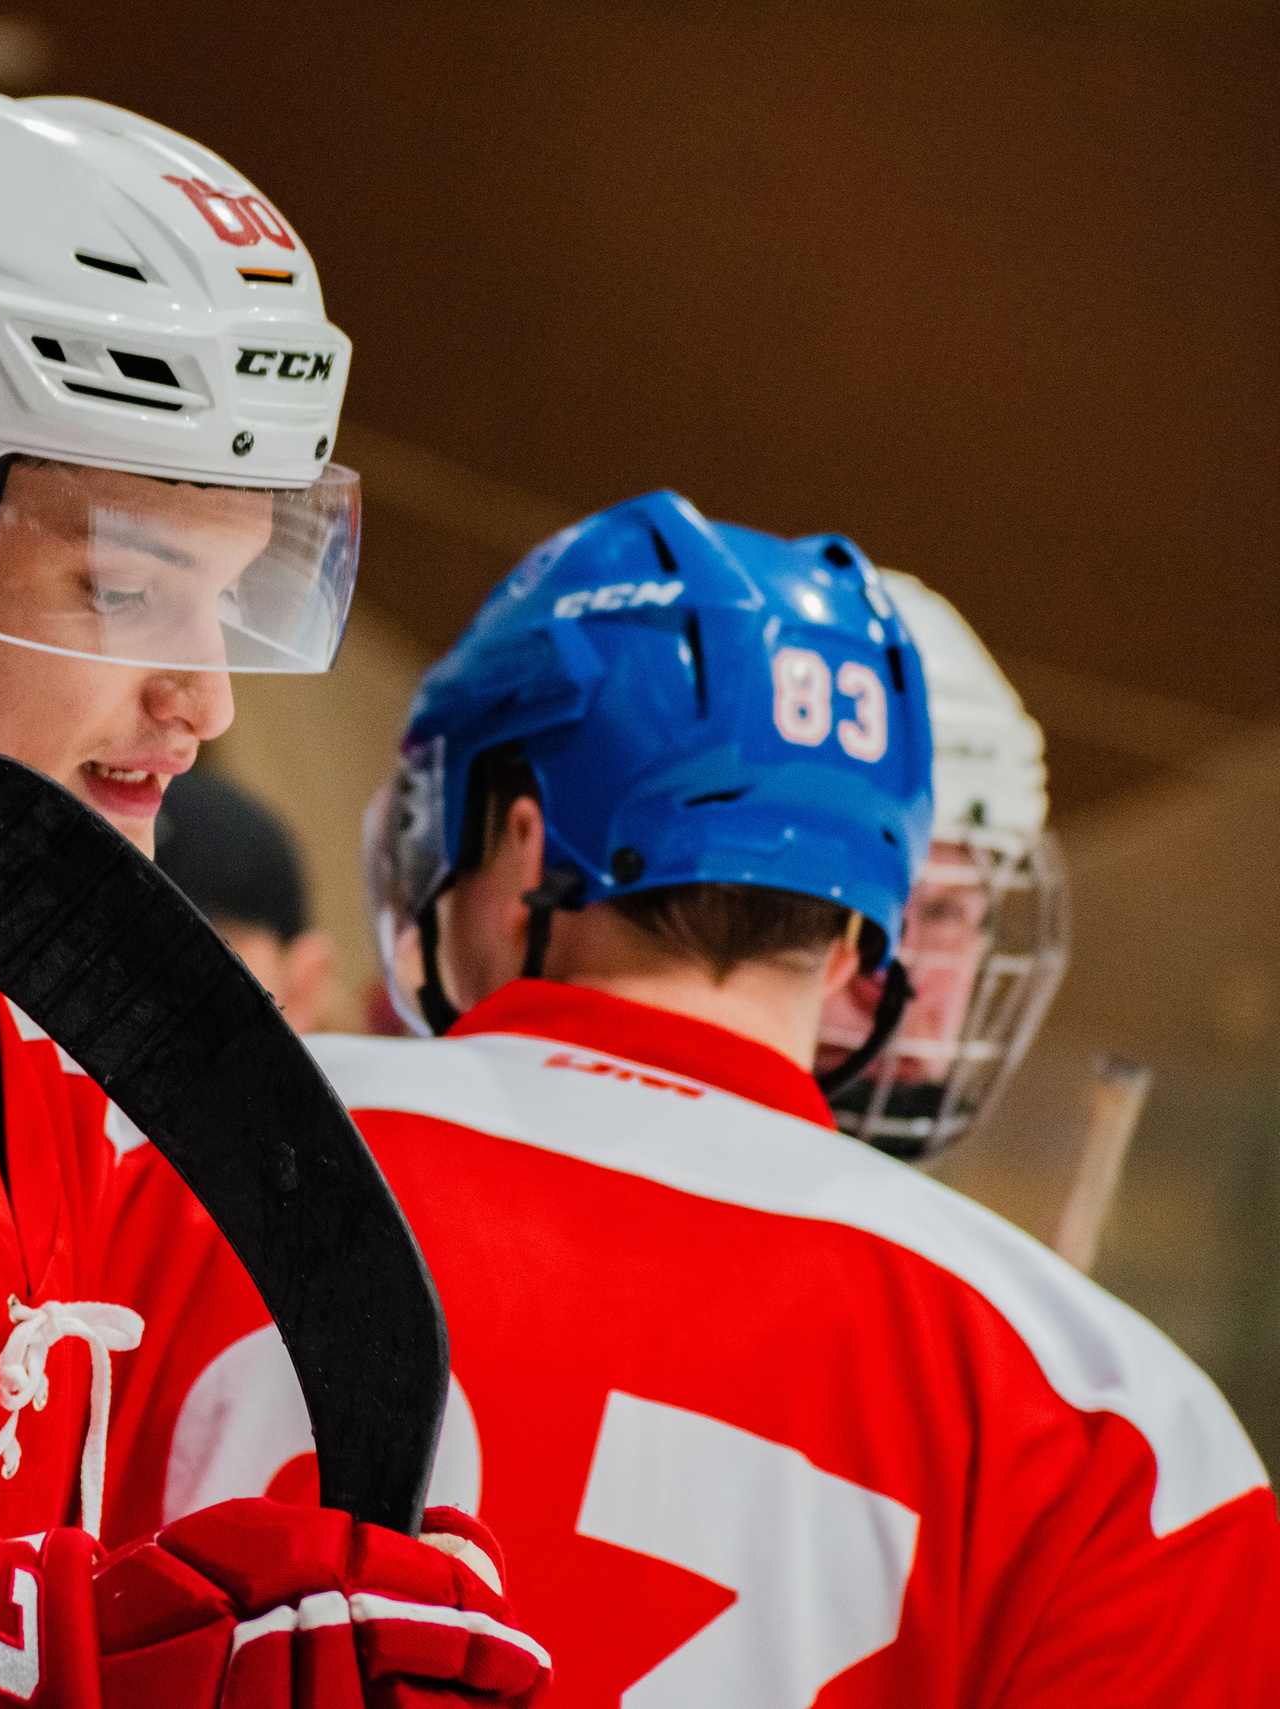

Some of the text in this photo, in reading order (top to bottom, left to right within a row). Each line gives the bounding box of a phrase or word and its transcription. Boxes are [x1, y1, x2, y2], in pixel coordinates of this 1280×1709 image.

[235, 346, 335, 383] CCM
[553, 580, 685, 619] CCM
[771, 645, 888, 763] 83
